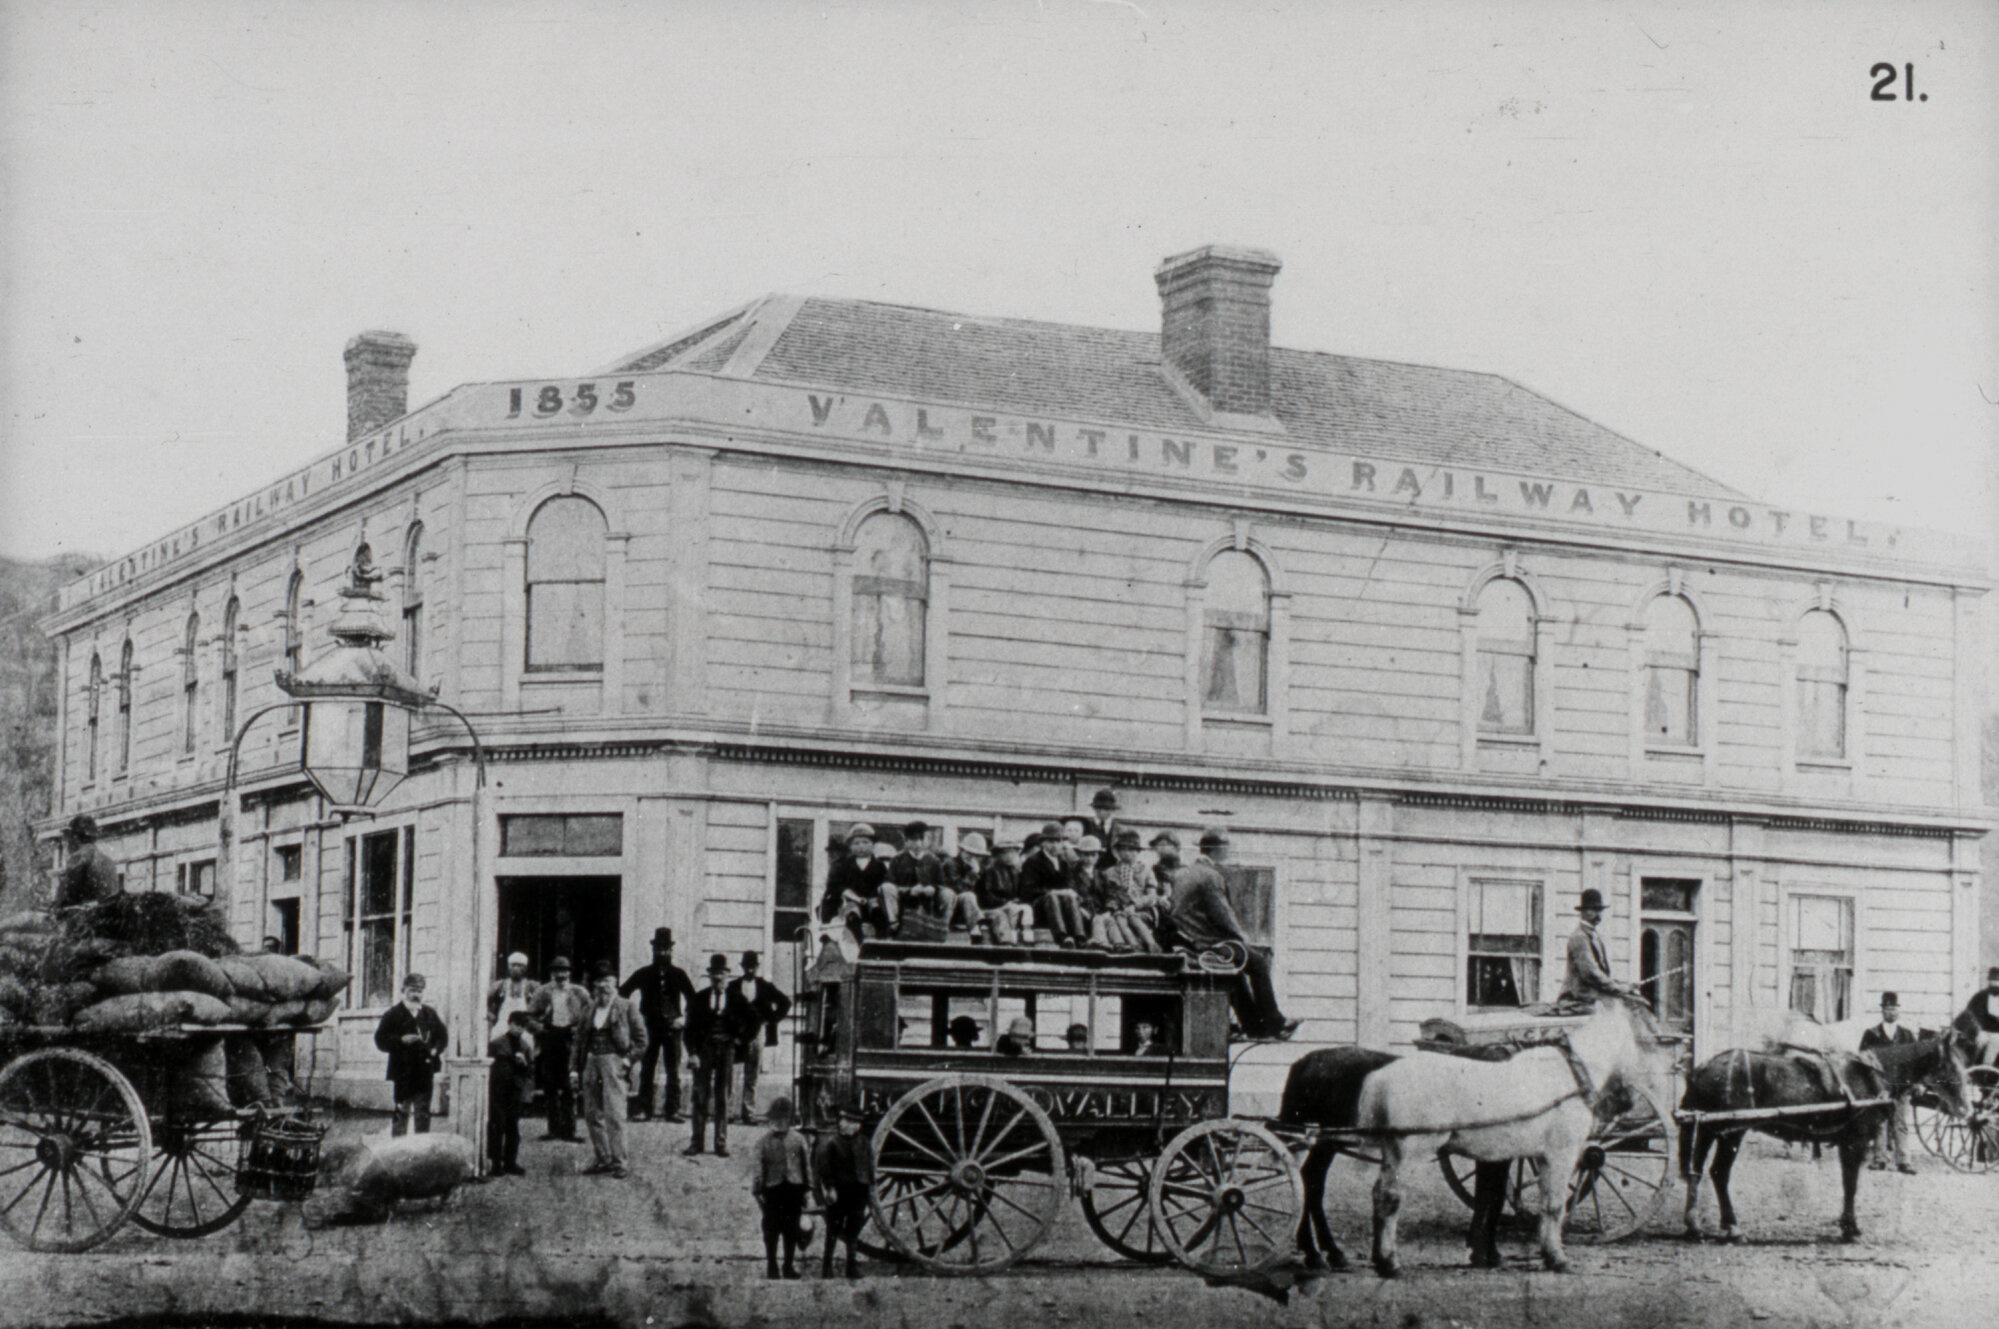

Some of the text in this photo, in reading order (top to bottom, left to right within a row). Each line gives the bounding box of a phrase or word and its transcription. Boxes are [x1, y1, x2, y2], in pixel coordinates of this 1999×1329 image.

[505, 381, 636, 420] 1855
[807, 394, 1307, 480] VALENTINE'S
[1350, 460, 1643, 517] RAILWAY
[218, 472, 312, 535] RAILWAY
[1055, 1090, 1201, 1119] VALLEY
